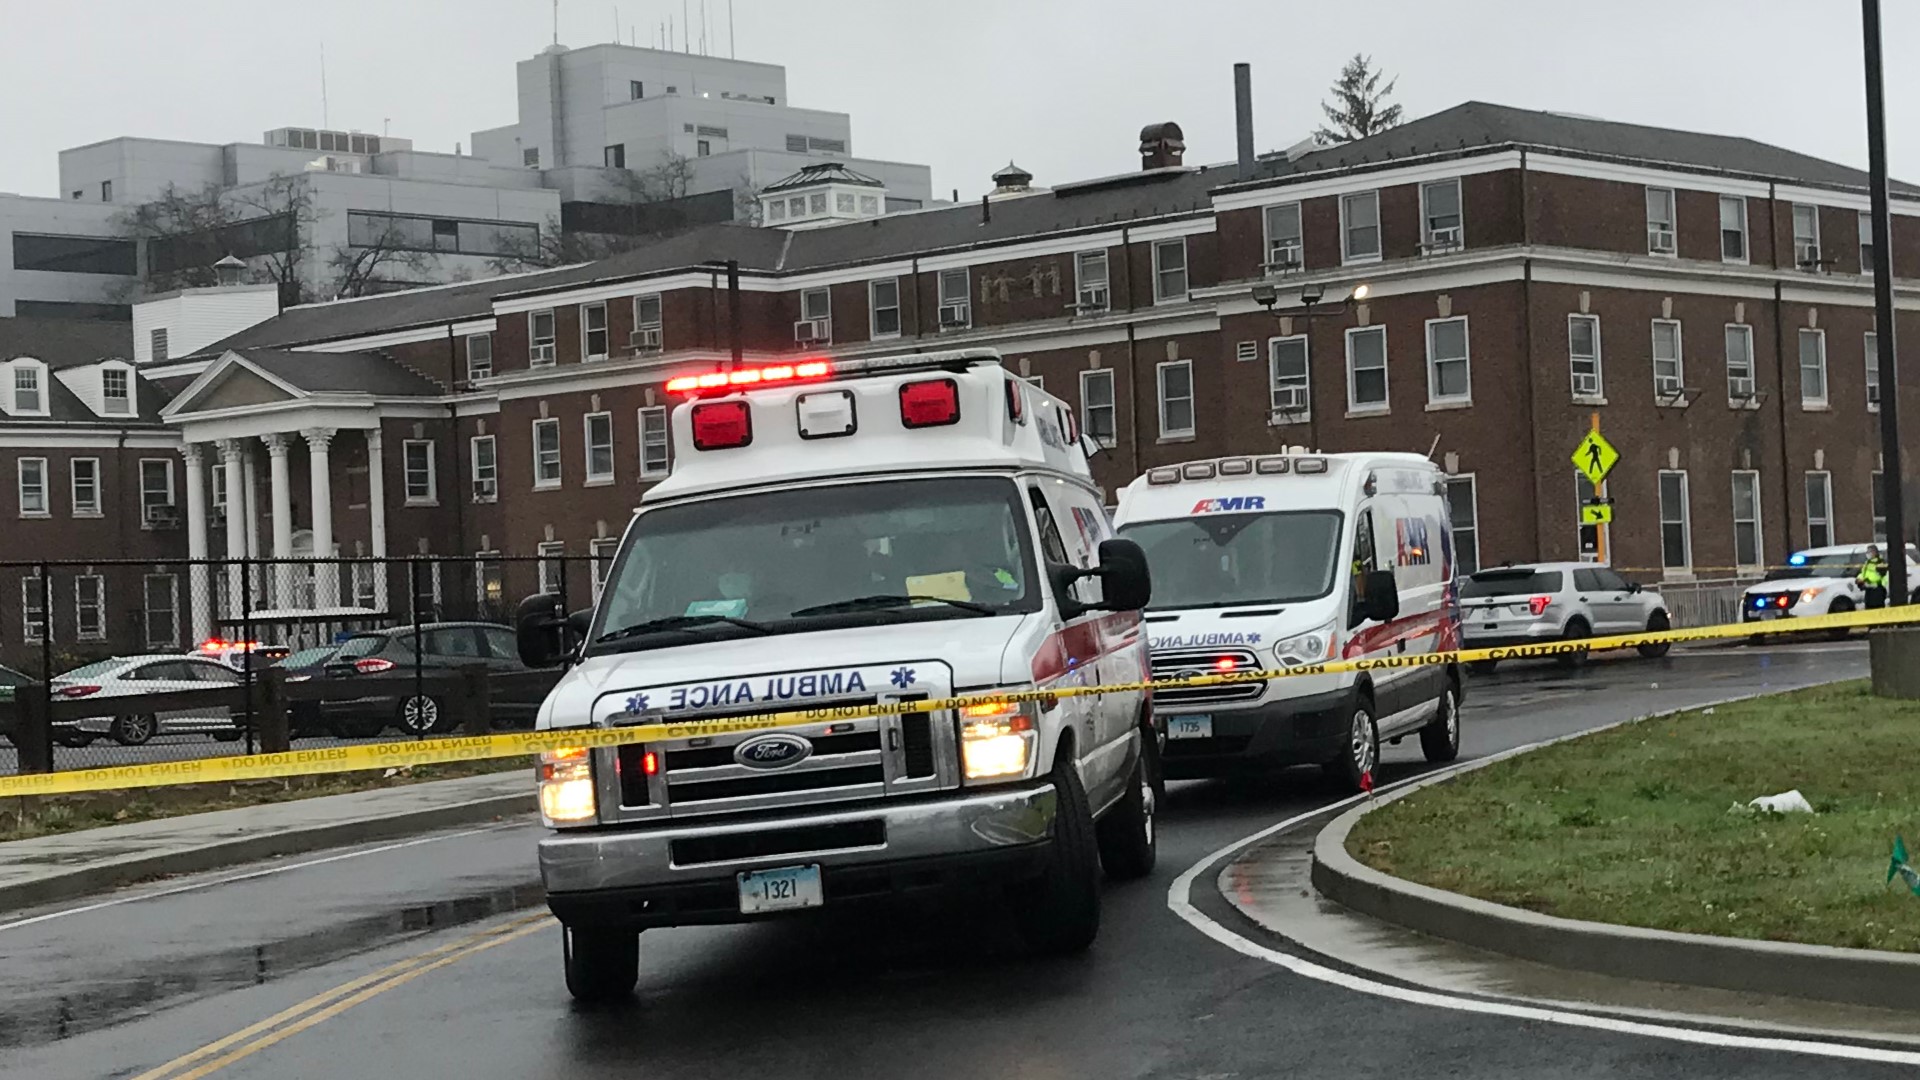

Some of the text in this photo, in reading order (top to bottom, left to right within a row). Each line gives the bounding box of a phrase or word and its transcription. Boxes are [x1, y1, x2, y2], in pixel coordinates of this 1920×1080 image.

[1191, 496, 1265, 514] AMR
[1488, 643, 1591, 659] CAUTION
[1355, 653, 1459, 670] CAUTION
[945, 692, 1056, 709] DO NOT ENTER
[806, 702, 917, 719] DO NOT ENTER
[754, 743, 788, 760] Ford
[763, 878, 797, 900] 1321
